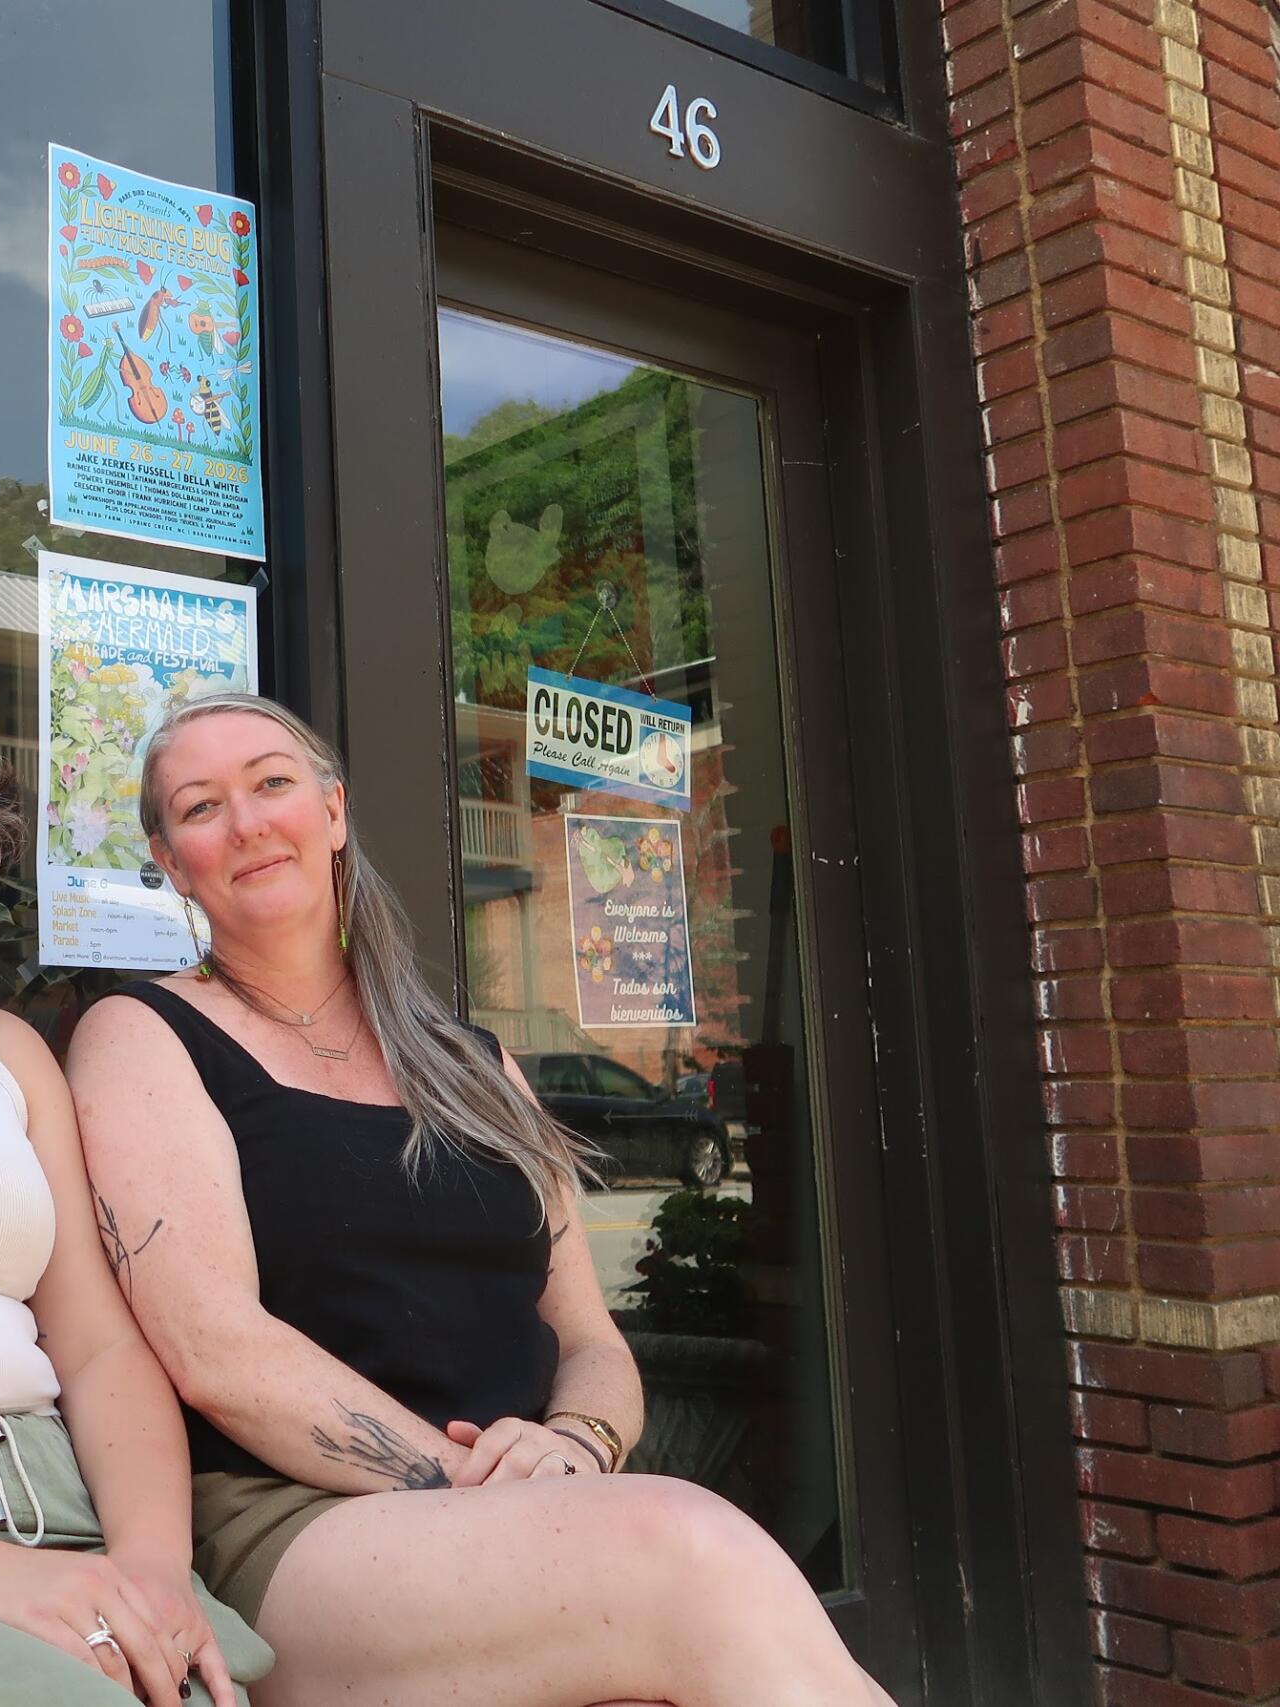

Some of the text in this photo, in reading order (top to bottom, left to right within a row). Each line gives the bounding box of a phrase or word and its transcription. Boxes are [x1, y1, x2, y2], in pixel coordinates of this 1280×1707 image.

[650, 84, 720, 168] 46
[137, 200, 172, 217] Presents
[146, 190, 176, 207] CULTURAL
[178, 206, 191, 222] ARTS
[80, 198, 231, 264] LIGHTNING BUG
[81, 228, 231, 277] TINY MUSIC FESTIVAL
[64, 431, 120, 457] JUNE
[129, 442, 153, 463] 26
[204, 458, 249, 484] 2026
[76, 452, 240, 493] JAKE XERXES FUSSELL BELLA WHITE
[77, 473, 103, 484] POWERS
[105, 478, 138, 490] ENSEMBLE
[144, 486, 170, 496] THOMAS
[132, 474, 156, 486] TATIANA
[158, 479, 196, 493] HARGREAVES
[73, 481, 105, 493] CRESCENT
[132, 492, 152, 502] FRANK
[193, 504, 210, 512] CAMP
[57, 575, 237, 634] MARSHALL'S
[96, 612, 211, 657] MERMAID
[75, 641, 225, 674] PARADE and FESTIVAL
[534, 688, 633, 755] CLOSED
[640, 713, 686, 734] WILL RETURN
[533, 741, 631, 777] Please Call Again
[67, 875, 97, 889] June
[52, 890, 67, 902] Live
[52, 905, 77, 919] Splash
[79, 906, 97, 918] Zone
[604, 899, 675, 924] Everyone is
[52, 920, 79, 932] Market
[613, 925, 668, 944] Welcome
[53, 934, 80, 946] Parade
[612, 977, 676, 996] Todos son
[610, 1004, 683, 1022] bienvenidos
